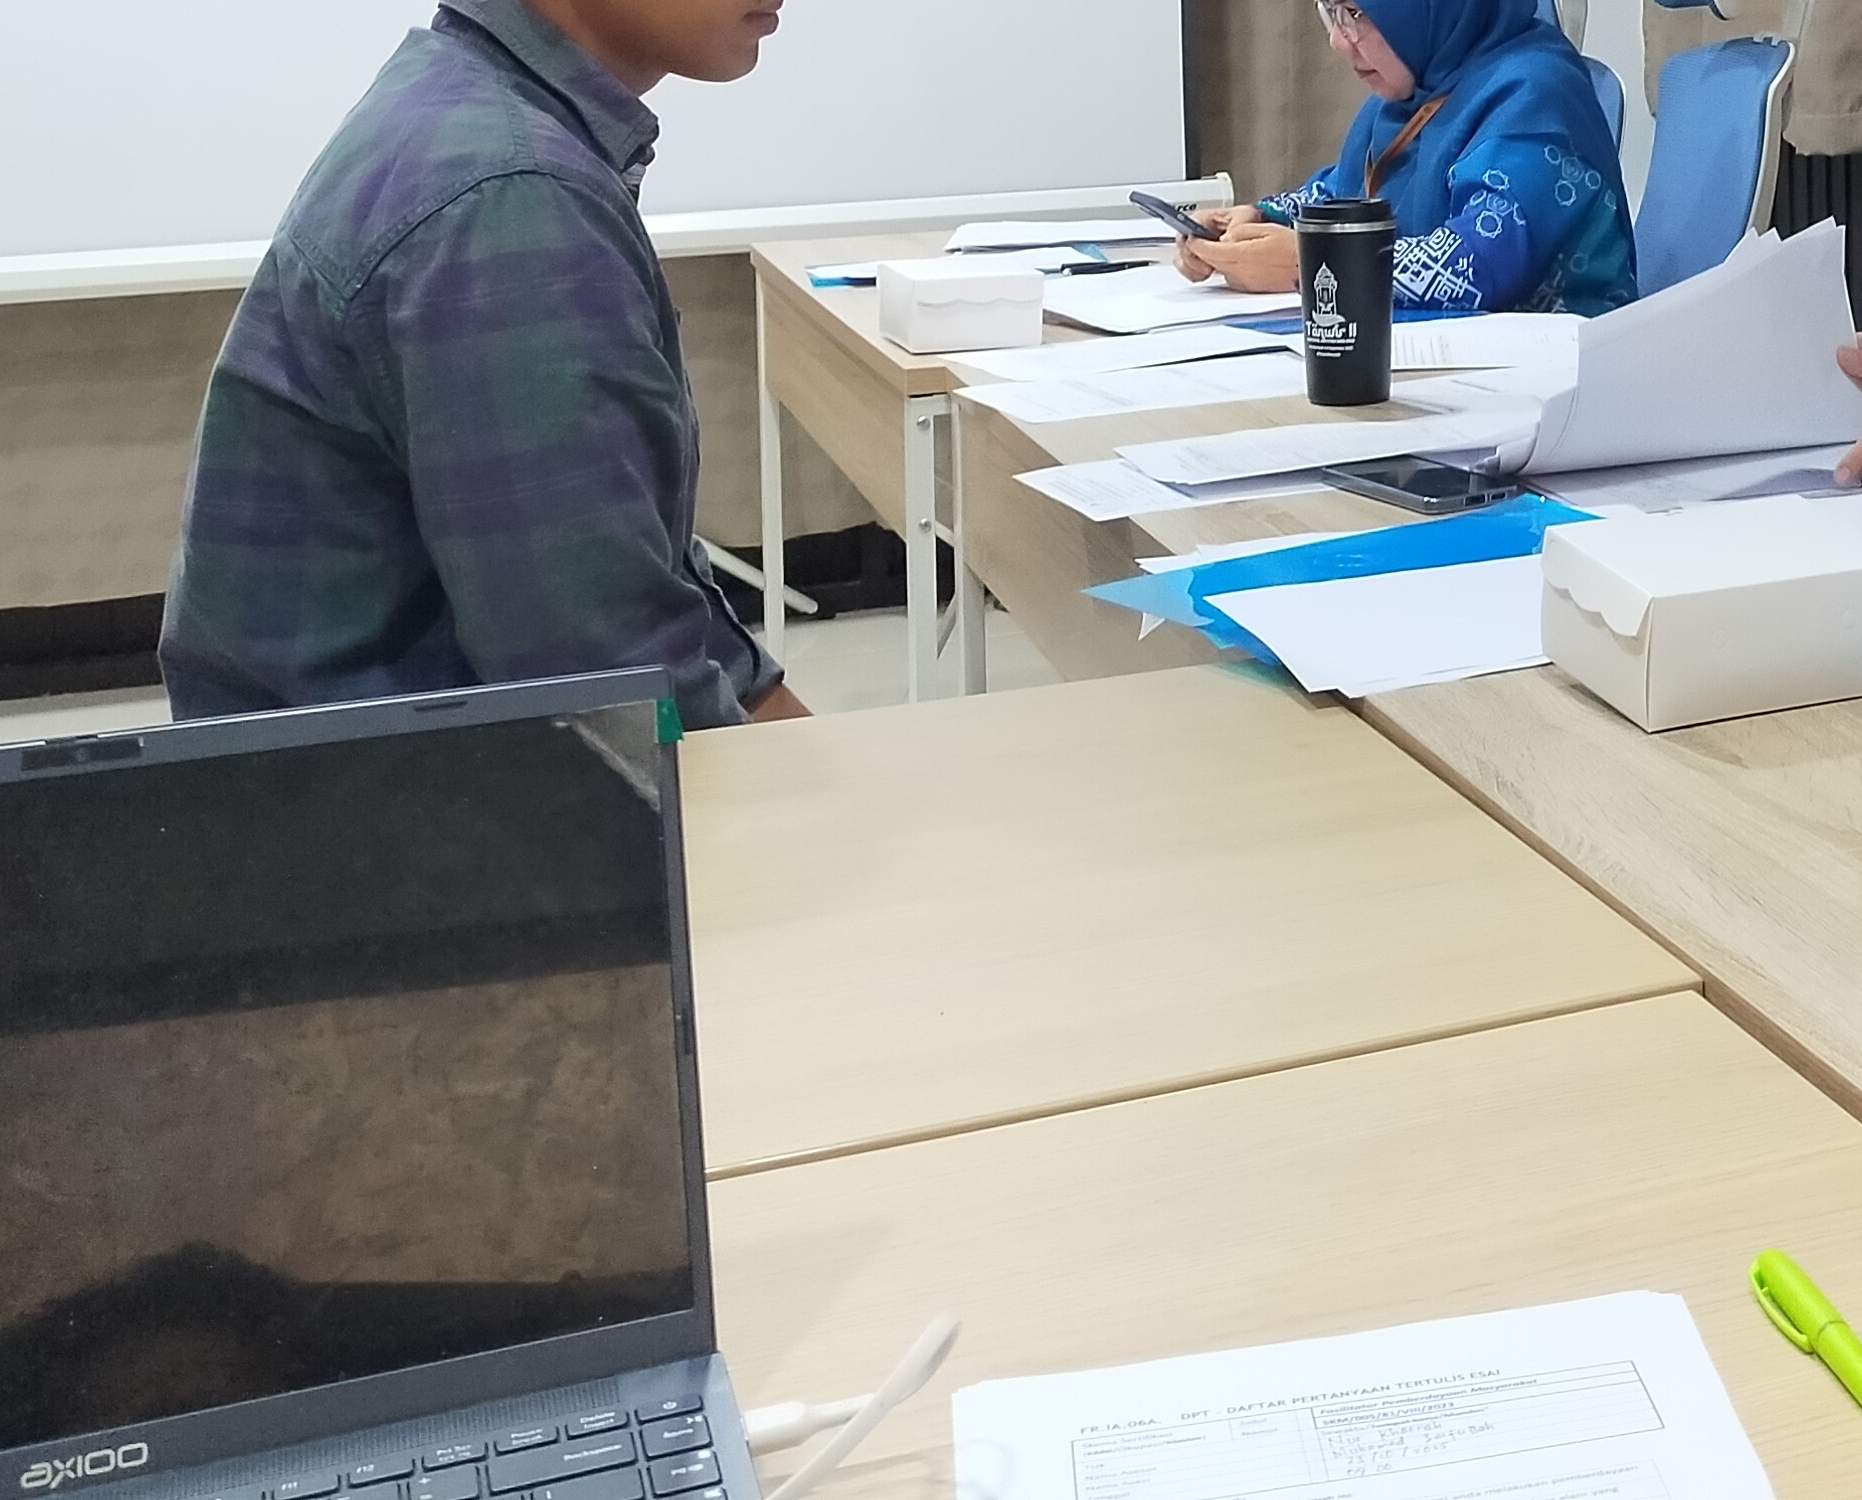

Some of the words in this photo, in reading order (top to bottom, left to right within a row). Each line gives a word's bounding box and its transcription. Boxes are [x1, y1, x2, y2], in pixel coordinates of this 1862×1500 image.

[1180, 1409, 1211, 1421] DPT
[1227, 1399, 1287, 1414] DAFTAR
[1291, 1385, 1391, 1404] PERTANYAAN
[1397, 1373, 1466, 1390] TERTULIS
[1470, 1369, 1501, 1379] ESAI
